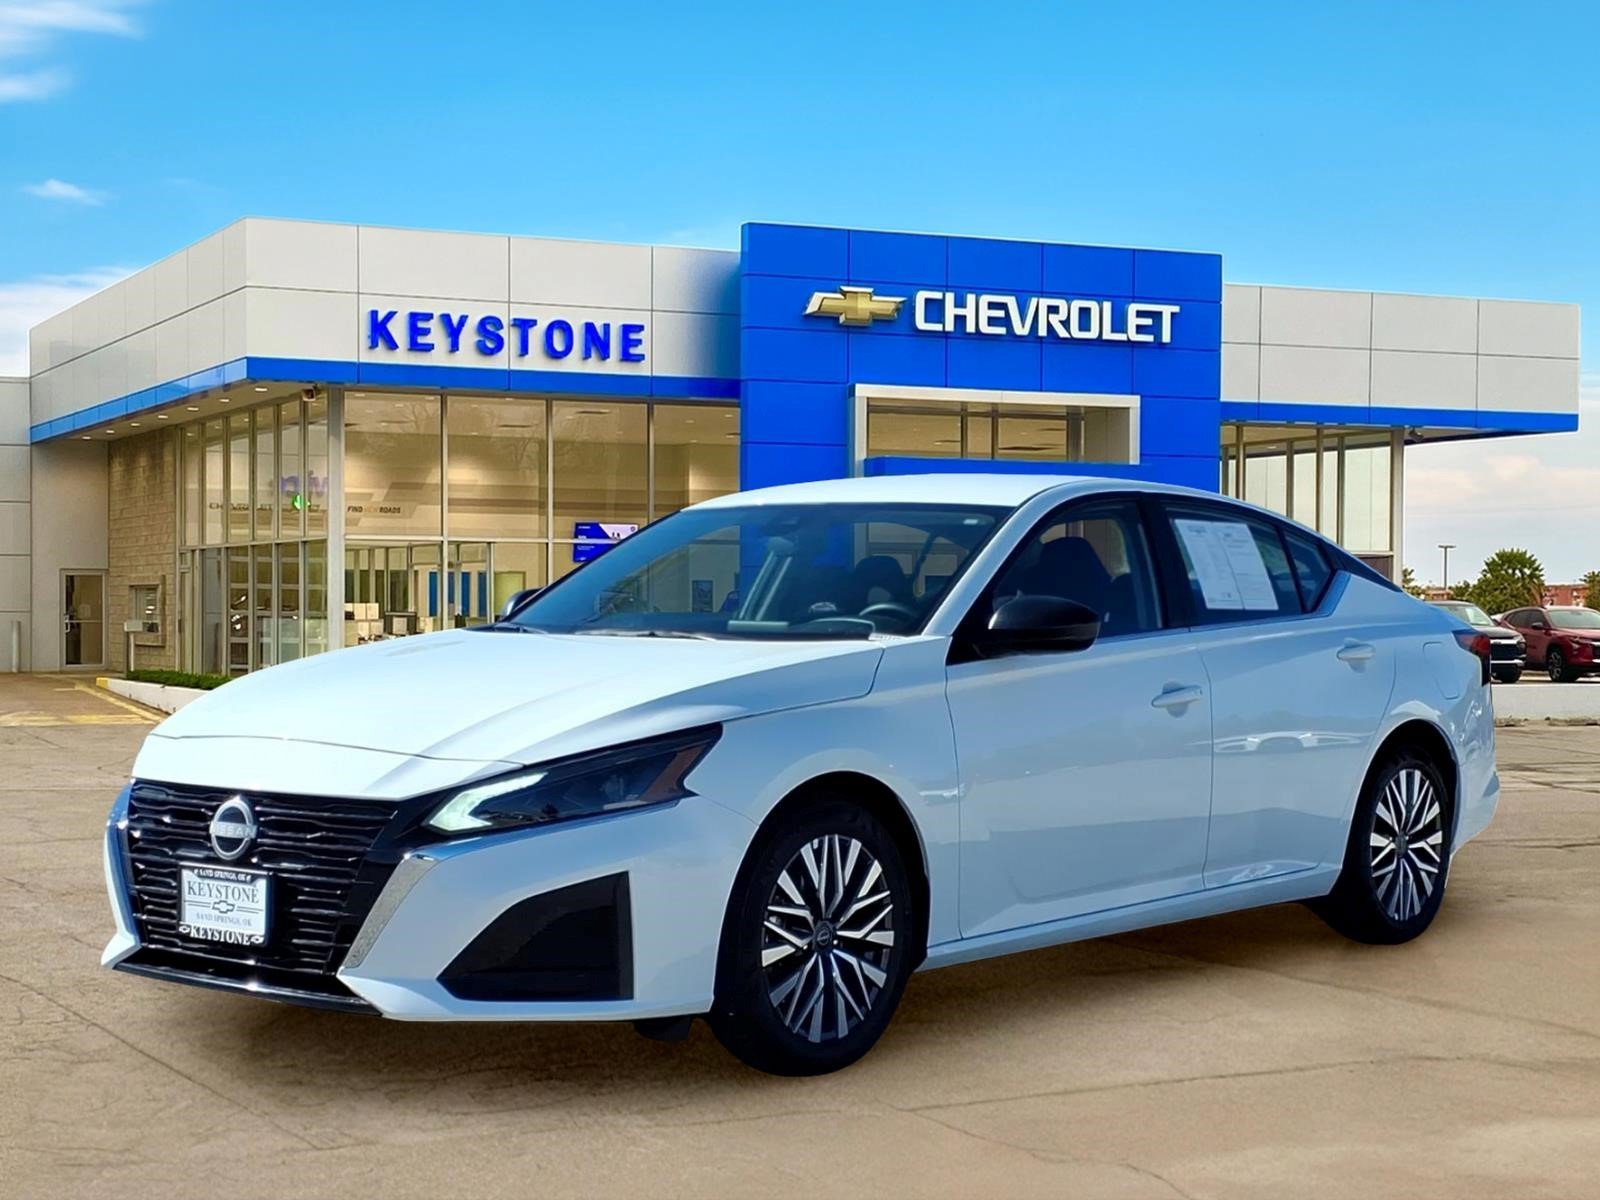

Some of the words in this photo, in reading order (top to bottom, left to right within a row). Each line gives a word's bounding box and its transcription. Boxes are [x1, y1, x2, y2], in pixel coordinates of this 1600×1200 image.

[915, 290, 1180, 343] CHEVROLET
[368, 309, 645, 363] KEYSTONE
[188, 881, 259, 903] KEYSTONE
[190, 926, 251, 945] KEYSTONE
